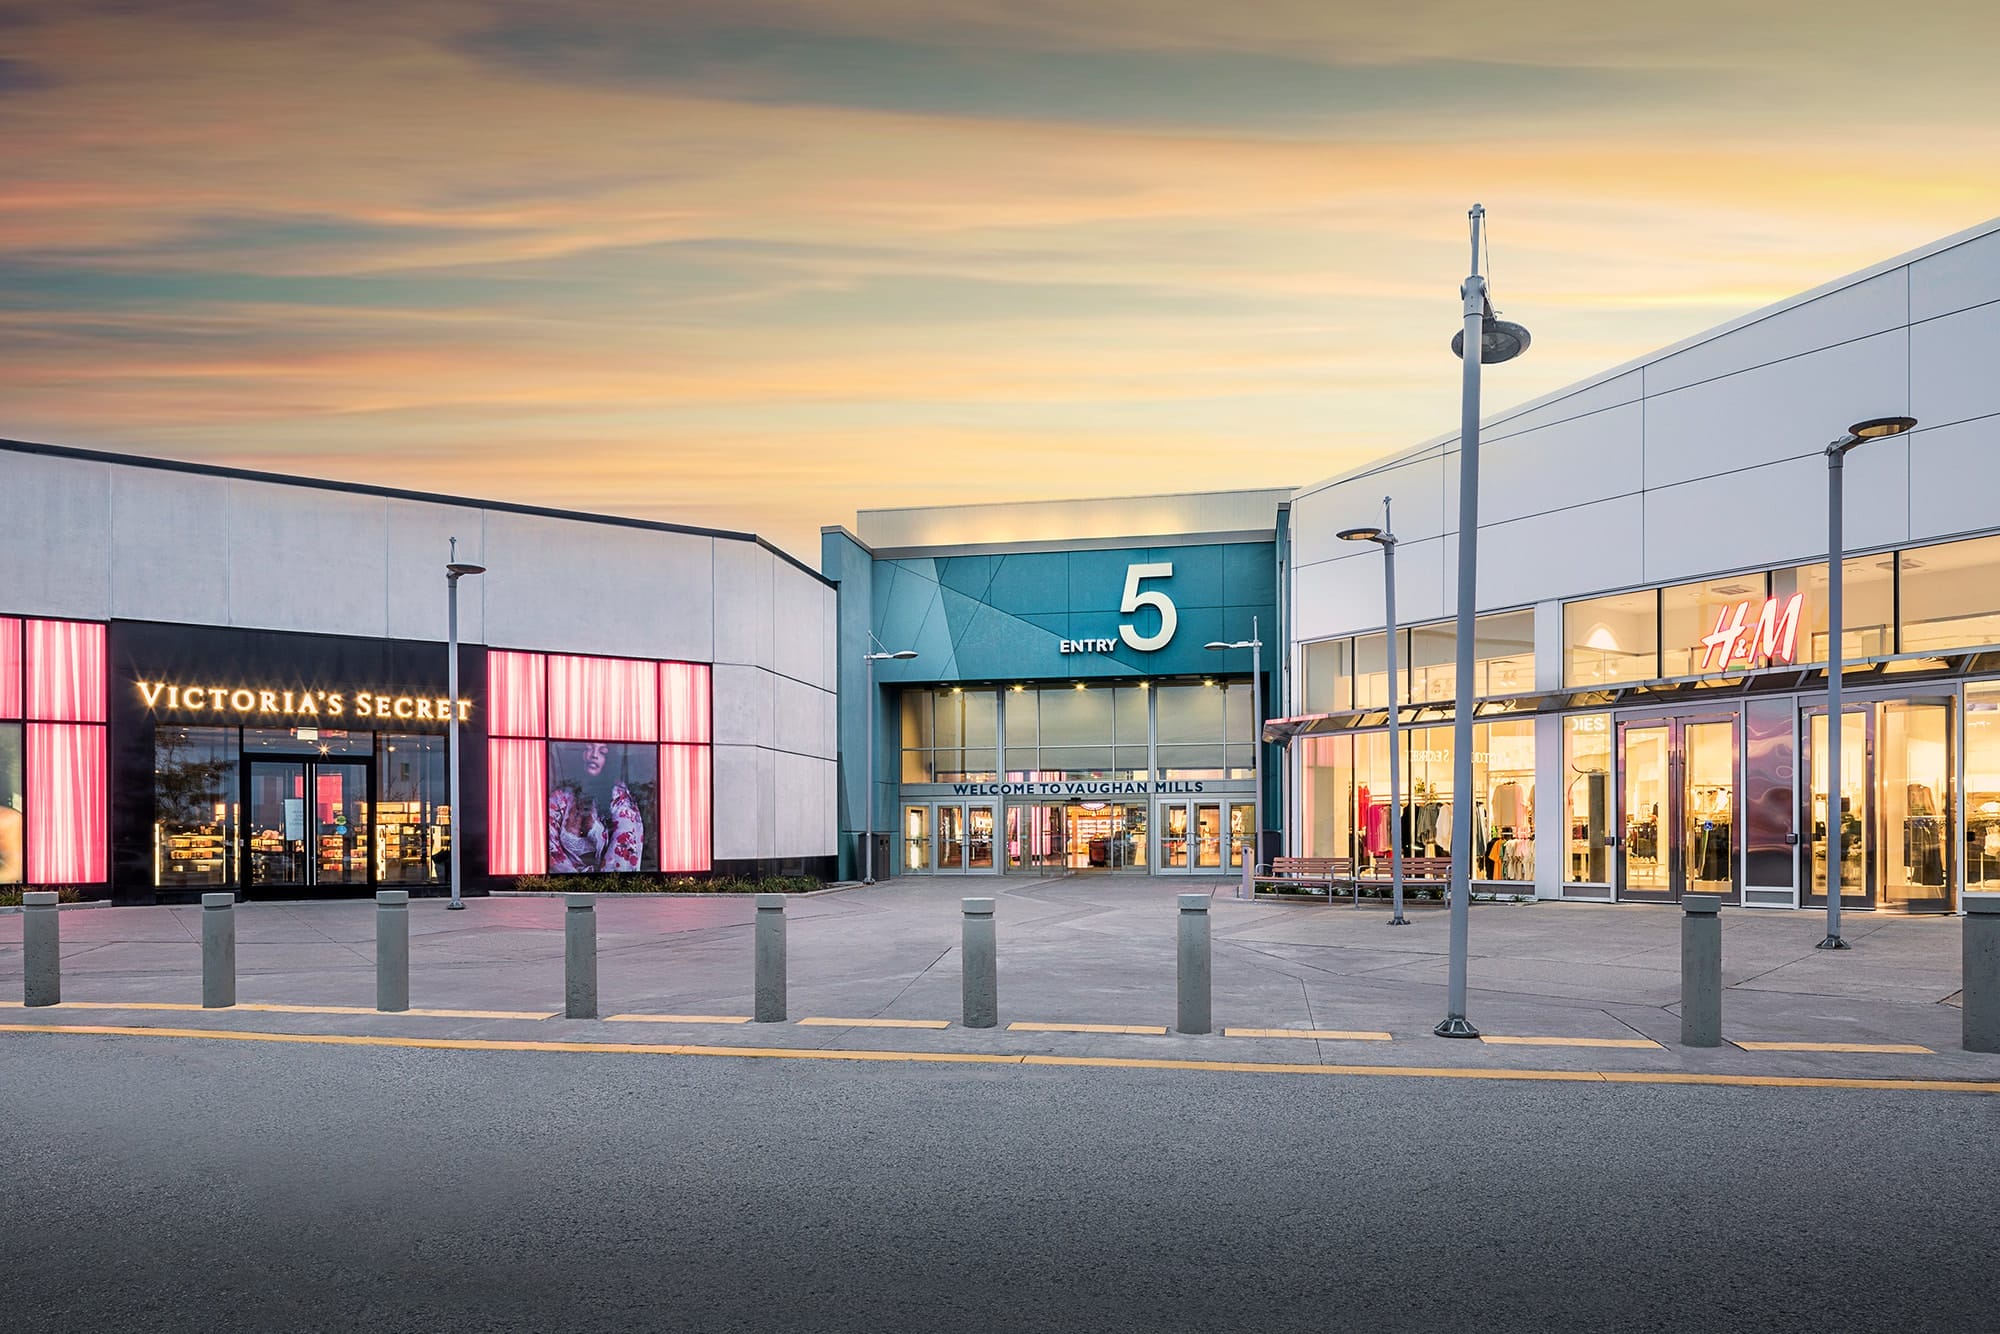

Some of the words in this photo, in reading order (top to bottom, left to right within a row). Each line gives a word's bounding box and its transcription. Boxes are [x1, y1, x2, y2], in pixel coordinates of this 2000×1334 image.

[1059, 638, 1118, 653] ENTRY
[1118, 561, 1178, 652] 5
[1700, 592, 1804, 669] H&M
[136, 681, 344, 716] VICTORIA'S
[356, 692, 472, 720] SECRET
[953, 783, 1035, 795] WELCOME
[1040, 783, 1061, 794] TO
[1065, 782, 1148, 794] VAUGHAN
[1155, 781, 1204, 793] MILLS
